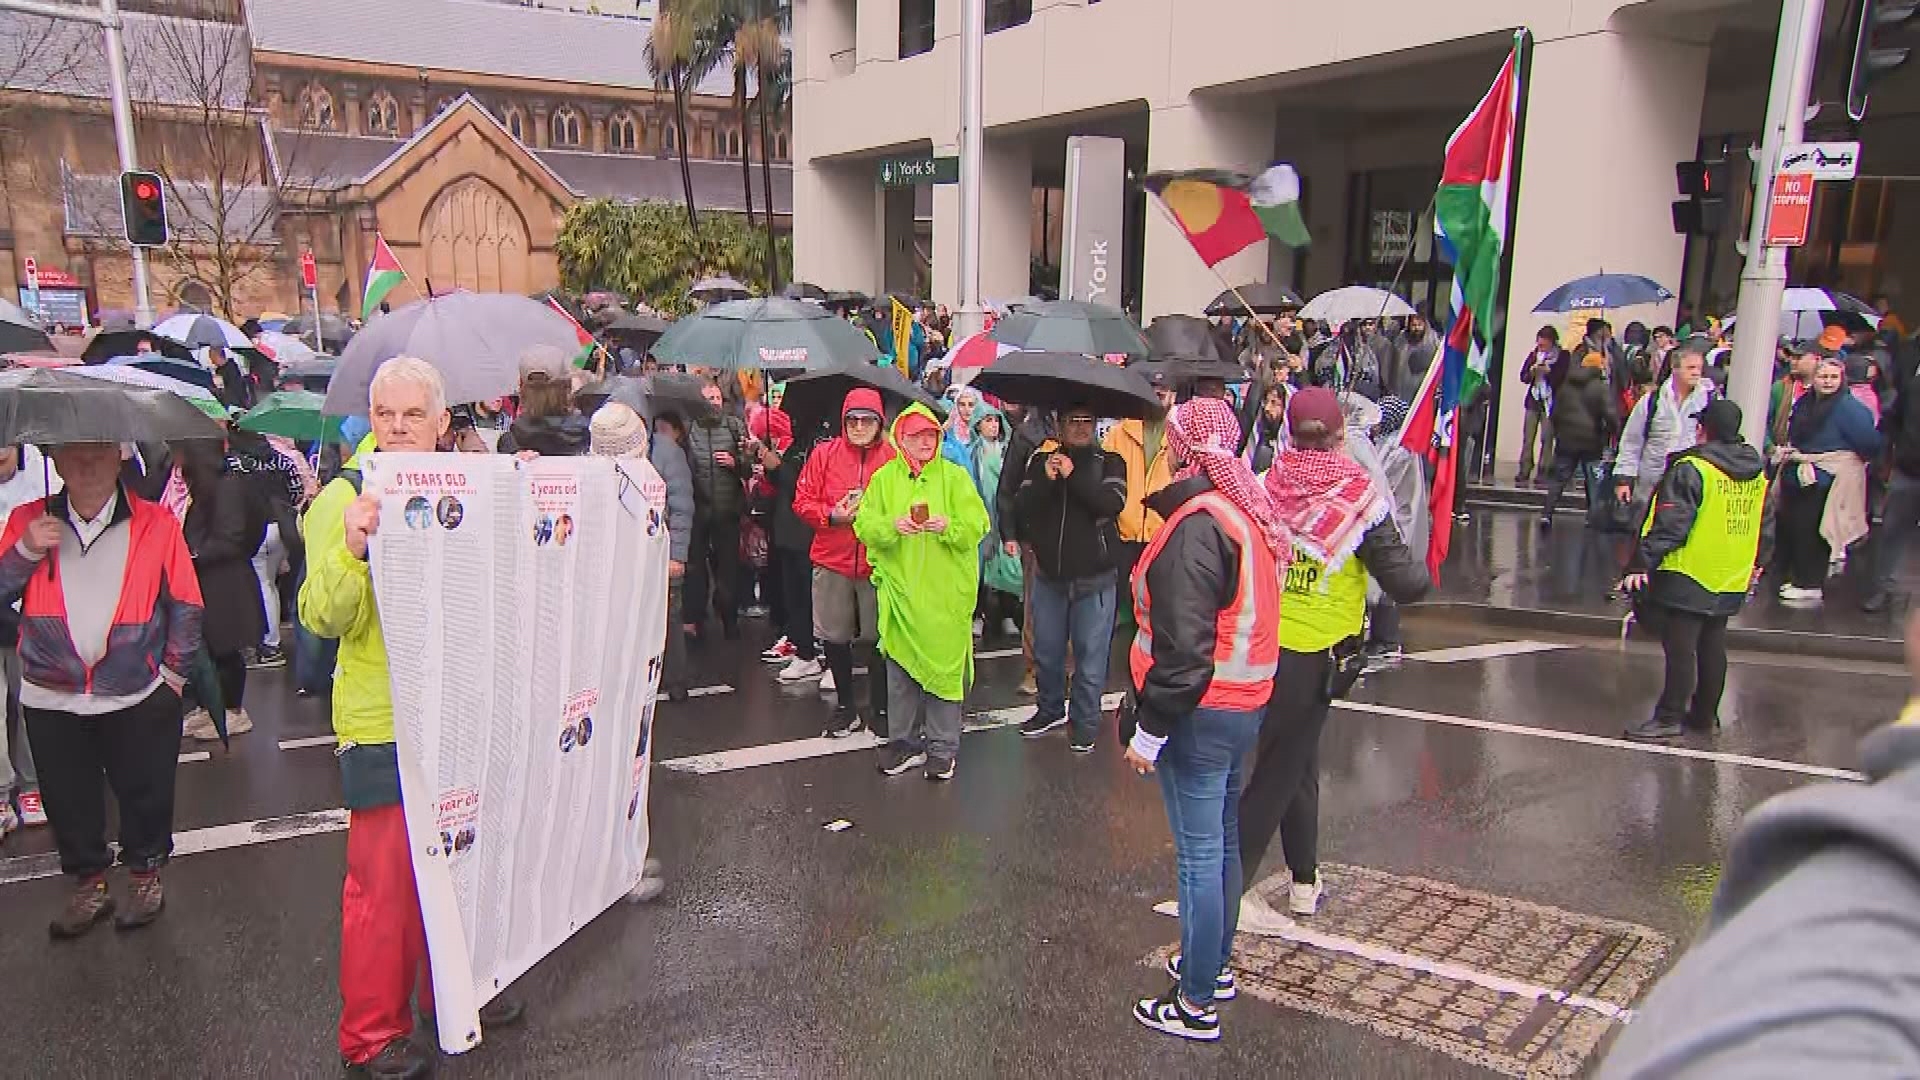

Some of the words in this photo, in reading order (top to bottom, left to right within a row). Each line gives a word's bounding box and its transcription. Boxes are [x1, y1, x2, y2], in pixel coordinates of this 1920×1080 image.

[899, 161, 922, 175] York
[925, 161, 936, 175] St
[1784, 181, 1801, 193] NO
[1774, 195, 1809, 205] STOPPING
[1088, 240, 1108, 303] York
[396, 473, 403, 487] 0
[405, 473, 443, 487] YEARS
[445, 473, 466, 487] OLD
[537, 485, 563, 498] years
[438, 797, 464, 817] year
[465, 789, 479, 807] old
